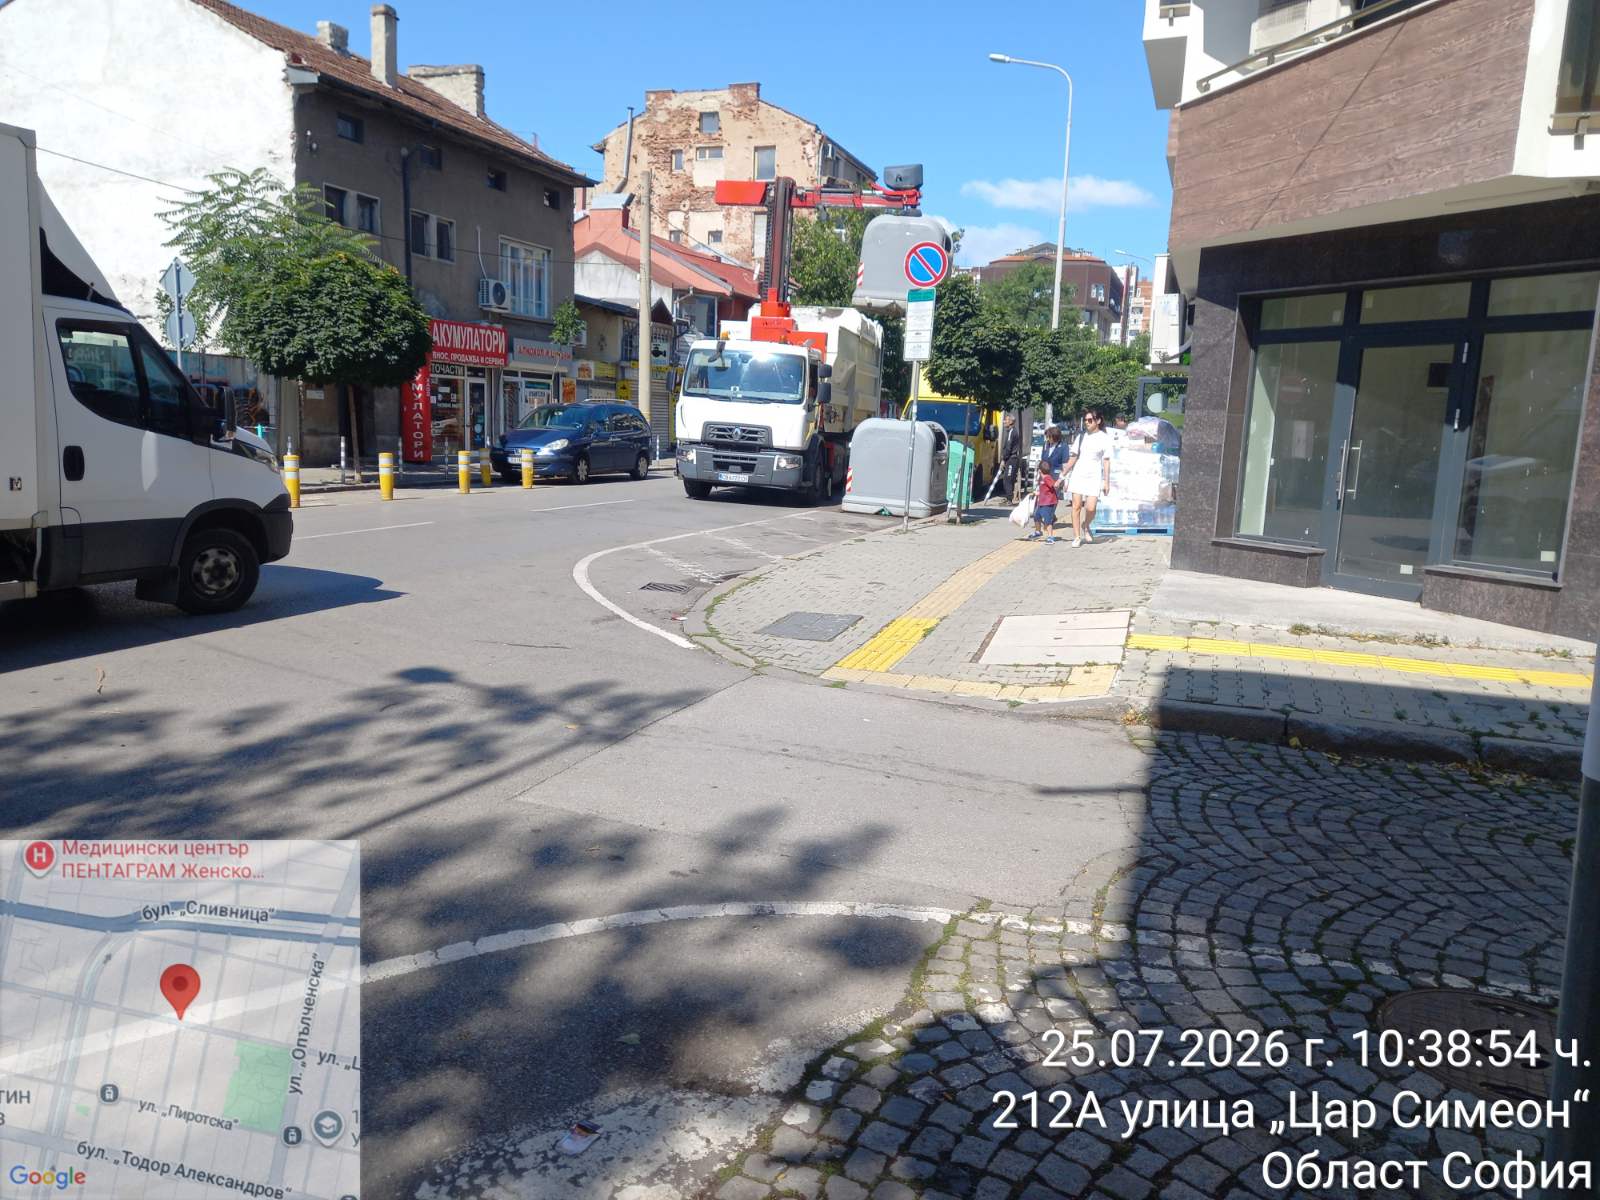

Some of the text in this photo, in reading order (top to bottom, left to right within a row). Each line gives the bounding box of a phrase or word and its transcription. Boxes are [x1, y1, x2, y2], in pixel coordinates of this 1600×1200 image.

[432, 321, 505, 354] АКУМУЛАТОРИ
[450, 353, 479, 364] ПРОДАЖБА
[431, 363, 464, 377] ТОЧАСТИ
